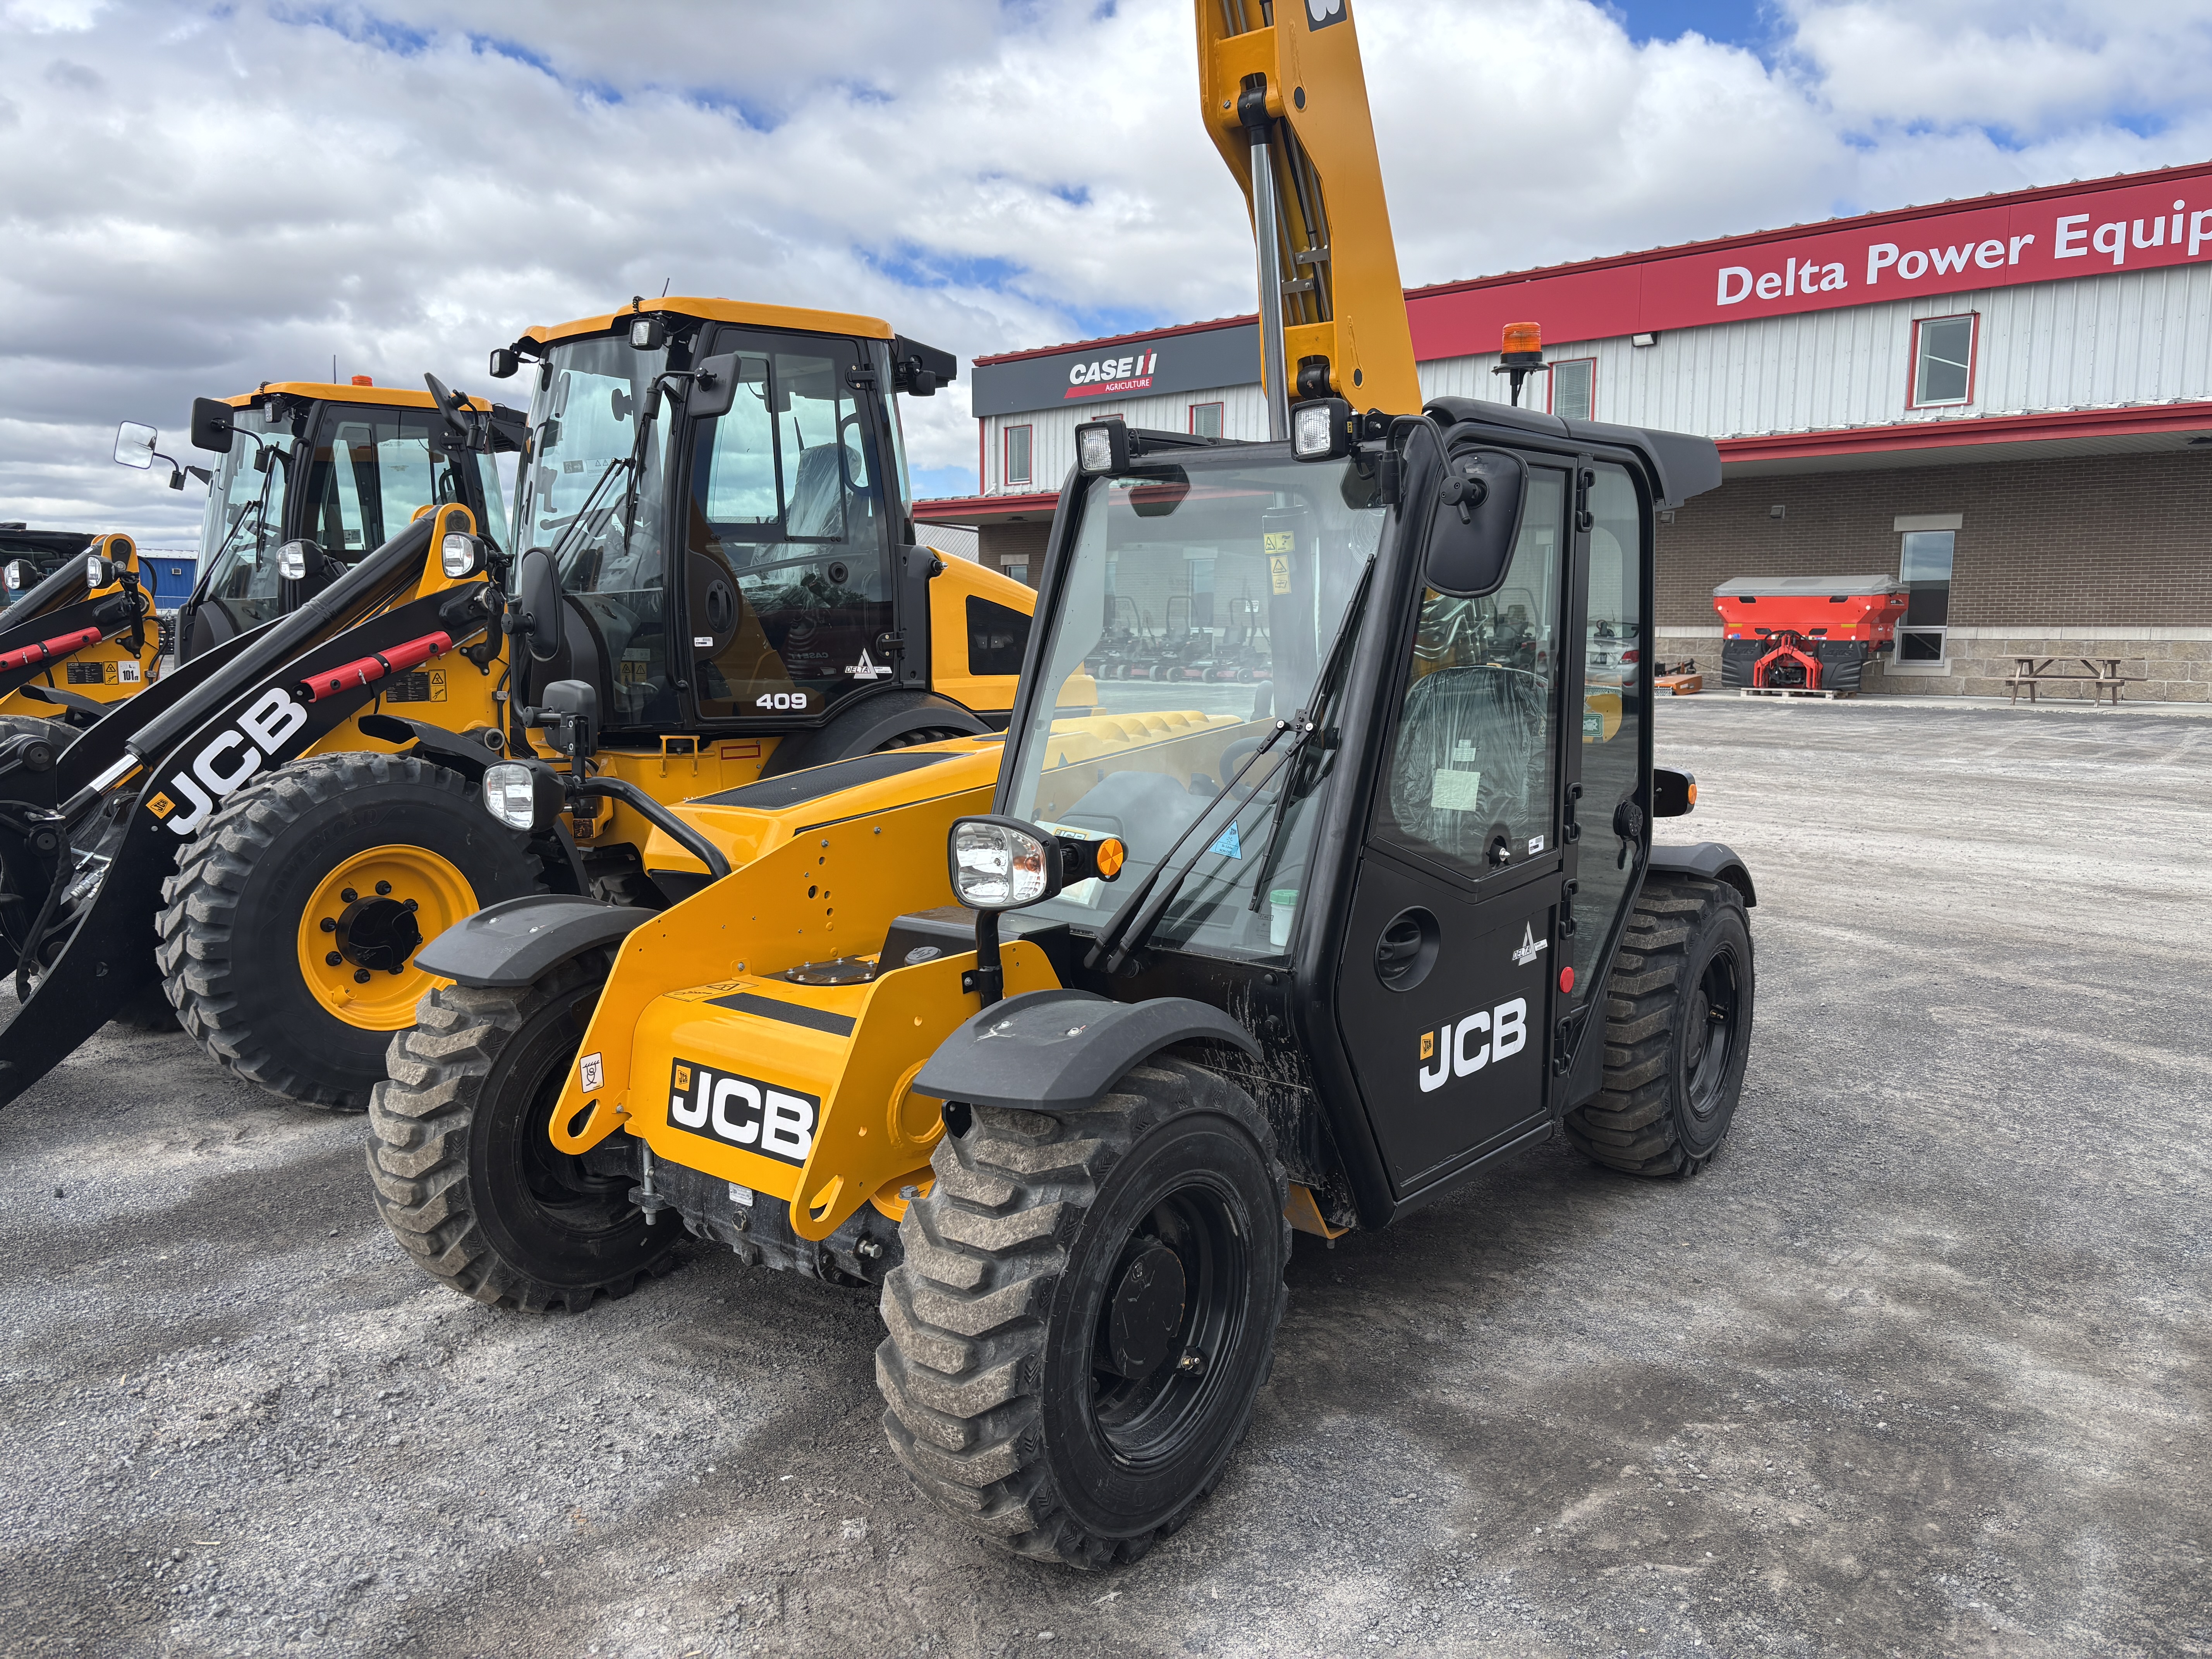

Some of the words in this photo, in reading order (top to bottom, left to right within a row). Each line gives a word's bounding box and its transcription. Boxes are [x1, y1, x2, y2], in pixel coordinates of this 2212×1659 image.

[1717, 257, 1848, 305] Delta
[1867, 234, 2035, 285] Power
[2054, 199, 2212, 265] Equip
[1069, 357, 1133, 385] CASE
[1105, 378, 1150, 392] AGRICULTURE
[756, 693, 807, 709] 409
[167, 687, 307, 835] JCB
[153, 800, 167, 811] JCB
[1513, 946, 1530, 959] DELTA
[1419, 997, 1527, 1092] JCB
[1424, 1040, 1432, 1052] JCB
[679, 1072, 689, 1084] JCB
[672, 1071, 814, 1160] JCB
